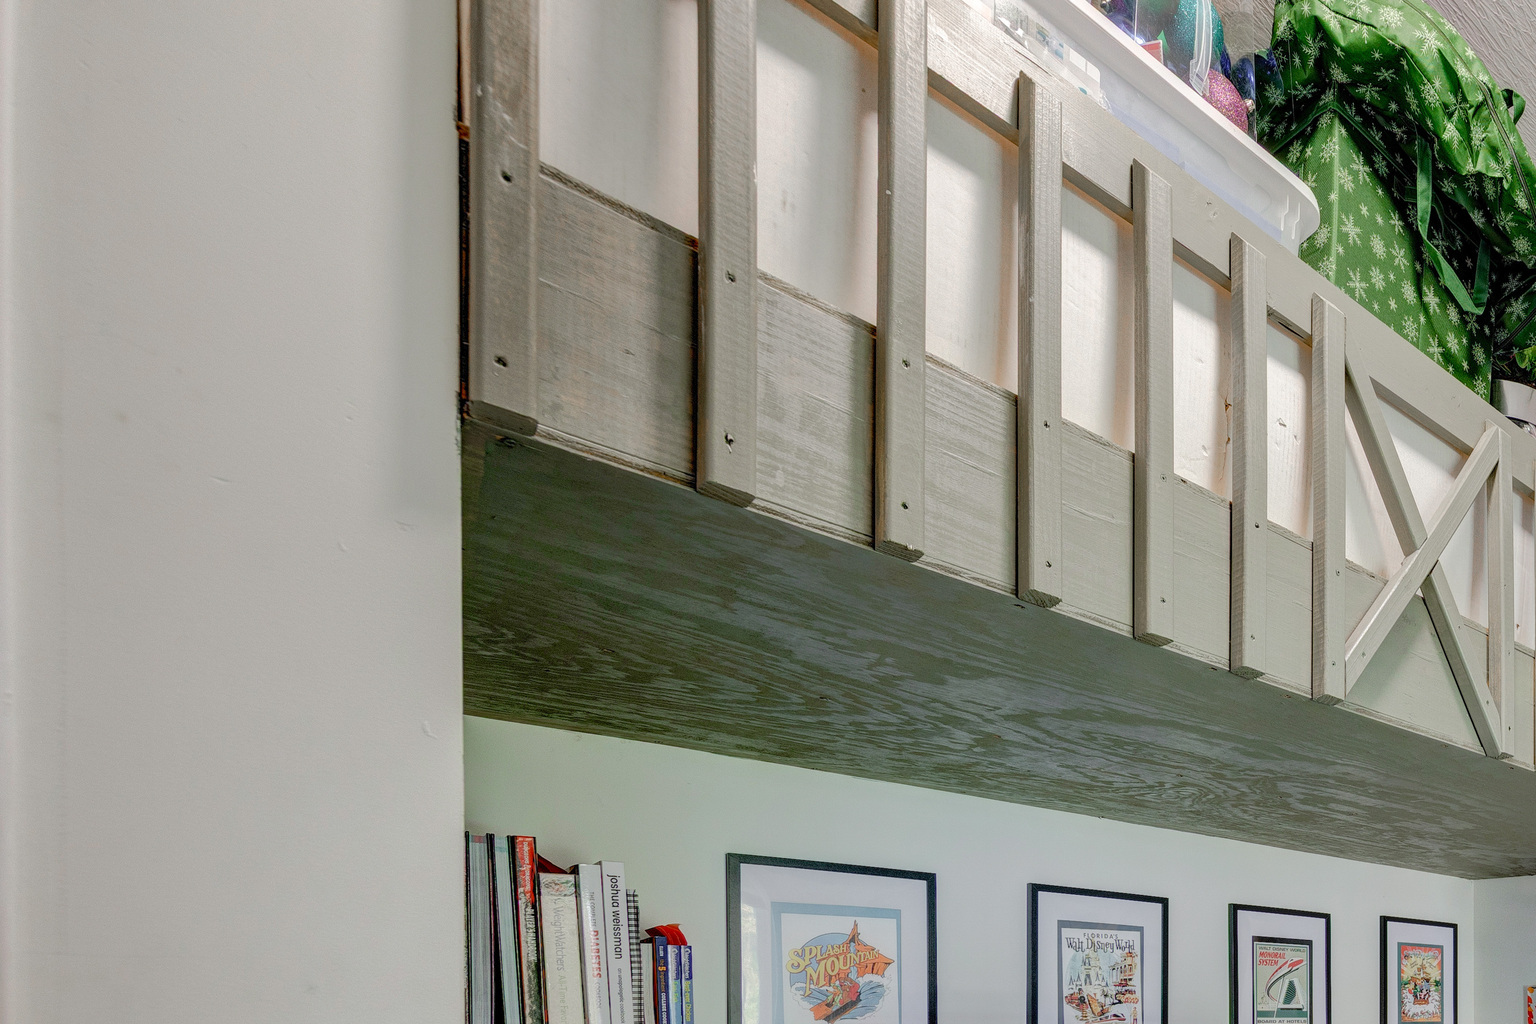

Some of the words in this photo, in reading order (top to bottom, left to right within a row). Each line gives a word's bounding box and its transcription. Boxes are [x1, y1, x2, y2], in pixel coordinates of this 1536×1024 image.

[606, 874, 621, 908] joshua
[612, 910, 624, 960] weissman
[1065, 937, 1085, 953] Walt
[1086, 937, 1115, 953] Disney
[1115, 939, 1135, 953] World
[590, 930, 602, 979] DIABETES
[786, 944, 847, 974] SPLASH
[1258, 951, 1286, 960] MONORAIL
[1258, 959, 1279, 967] SYSTEM
[803, 950, 879, 998] MOUNTAIN
